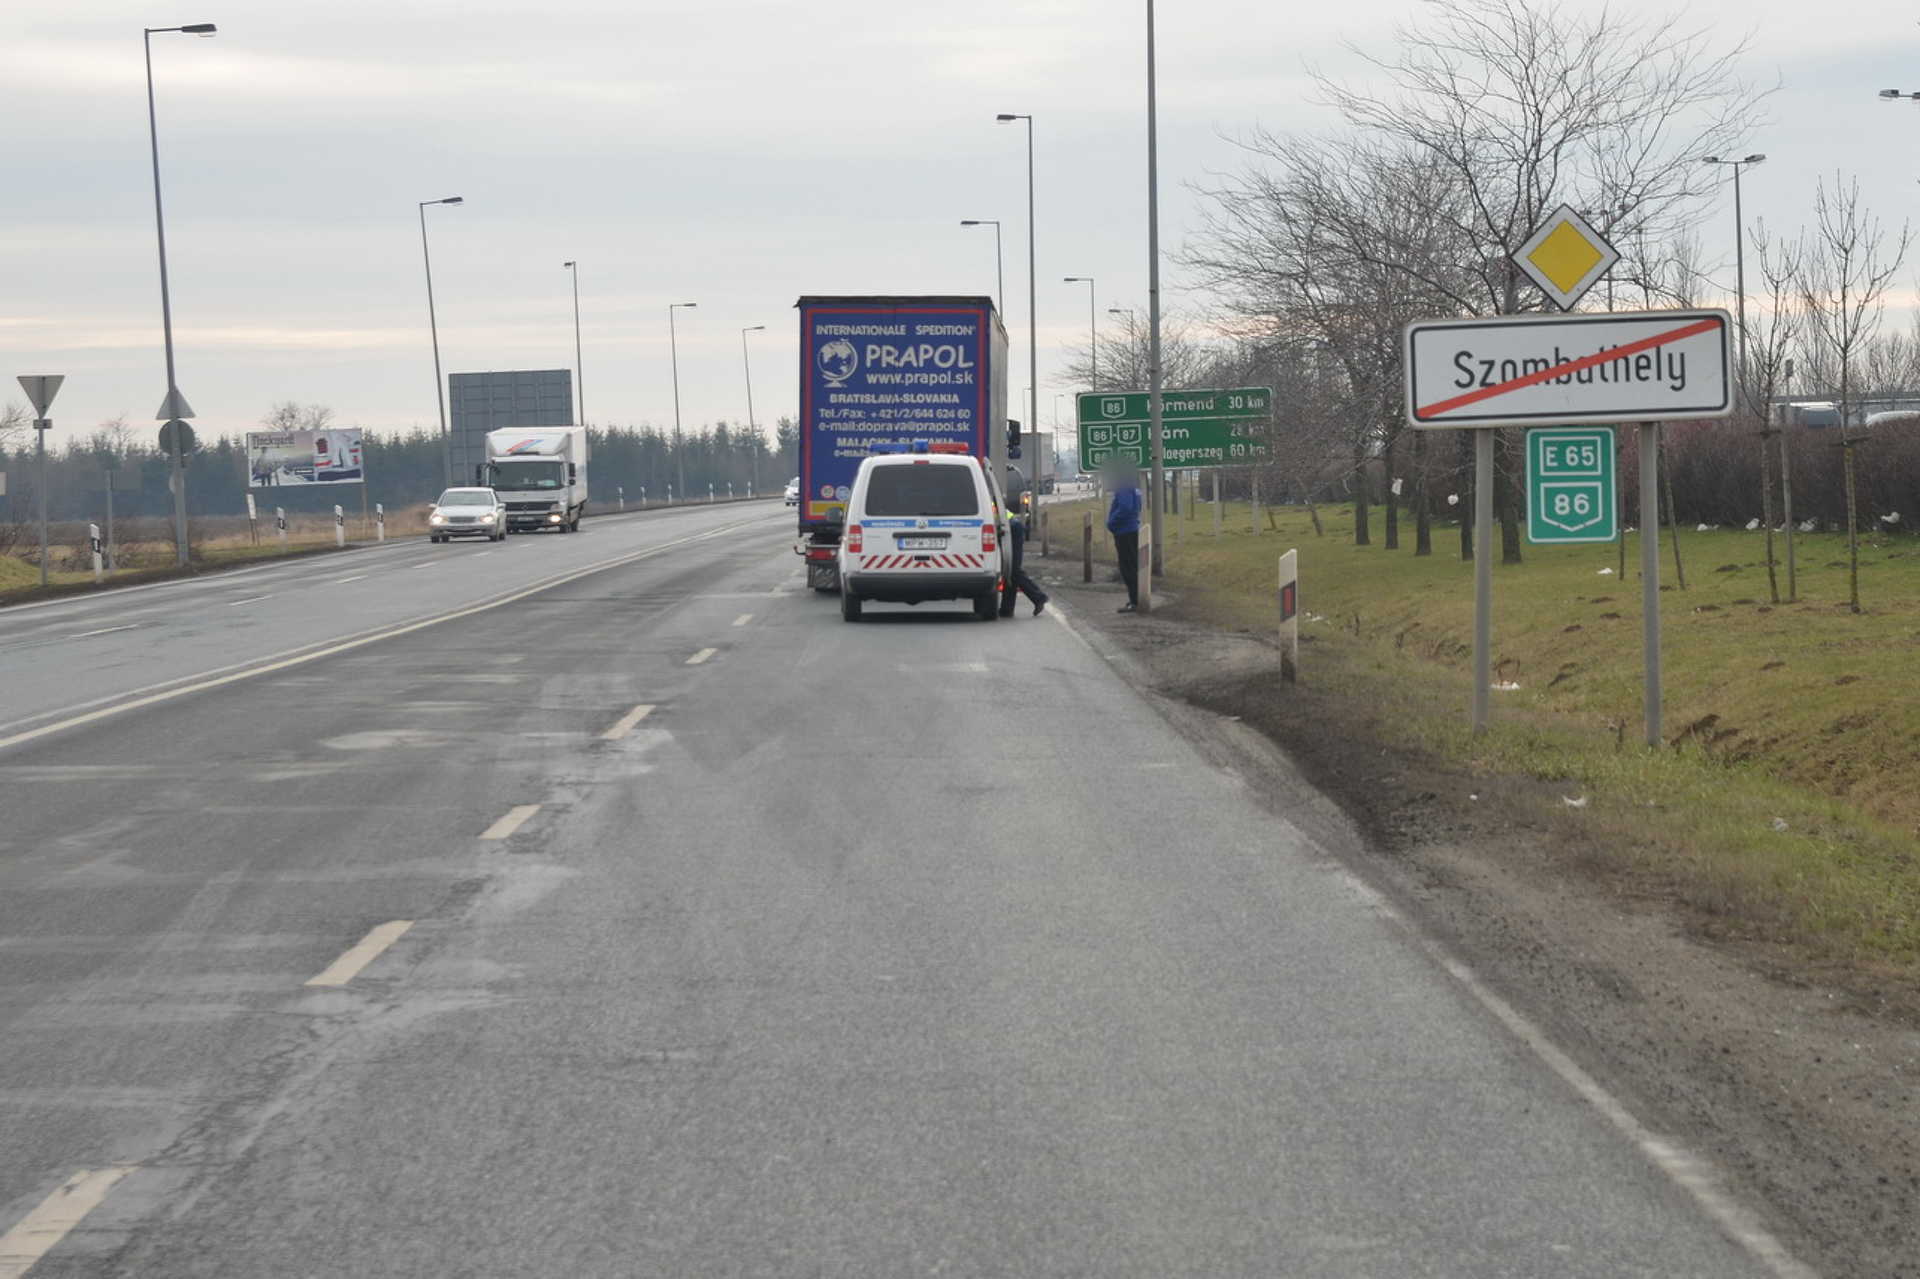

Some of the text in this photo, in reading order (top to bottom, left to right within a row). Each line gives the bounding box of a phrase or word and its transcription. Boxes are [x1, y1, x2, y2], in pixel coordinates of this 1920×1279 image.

[816, 325, 973, 335] INTERNATIONALE SPEDITION
[865, 344, 974, 368] PRAPOL
[1453, 344, 1686, 391] Szombathely
[866, 371, 974, 386] www.prapol.sk
[1106, 402, 1120, 413] 86
[1228, 395, 1264, 409] 30 km
[1093, 430, 1107, 441] 86
[1122, 428, 1136, 440] 87
[1149, 447, 1223, 462] laegerszeg
[1229, 444, 1245, 457] 60
[1545, 446, 1595, 467] E 65
[1554, 493, 1590, 516] 86
